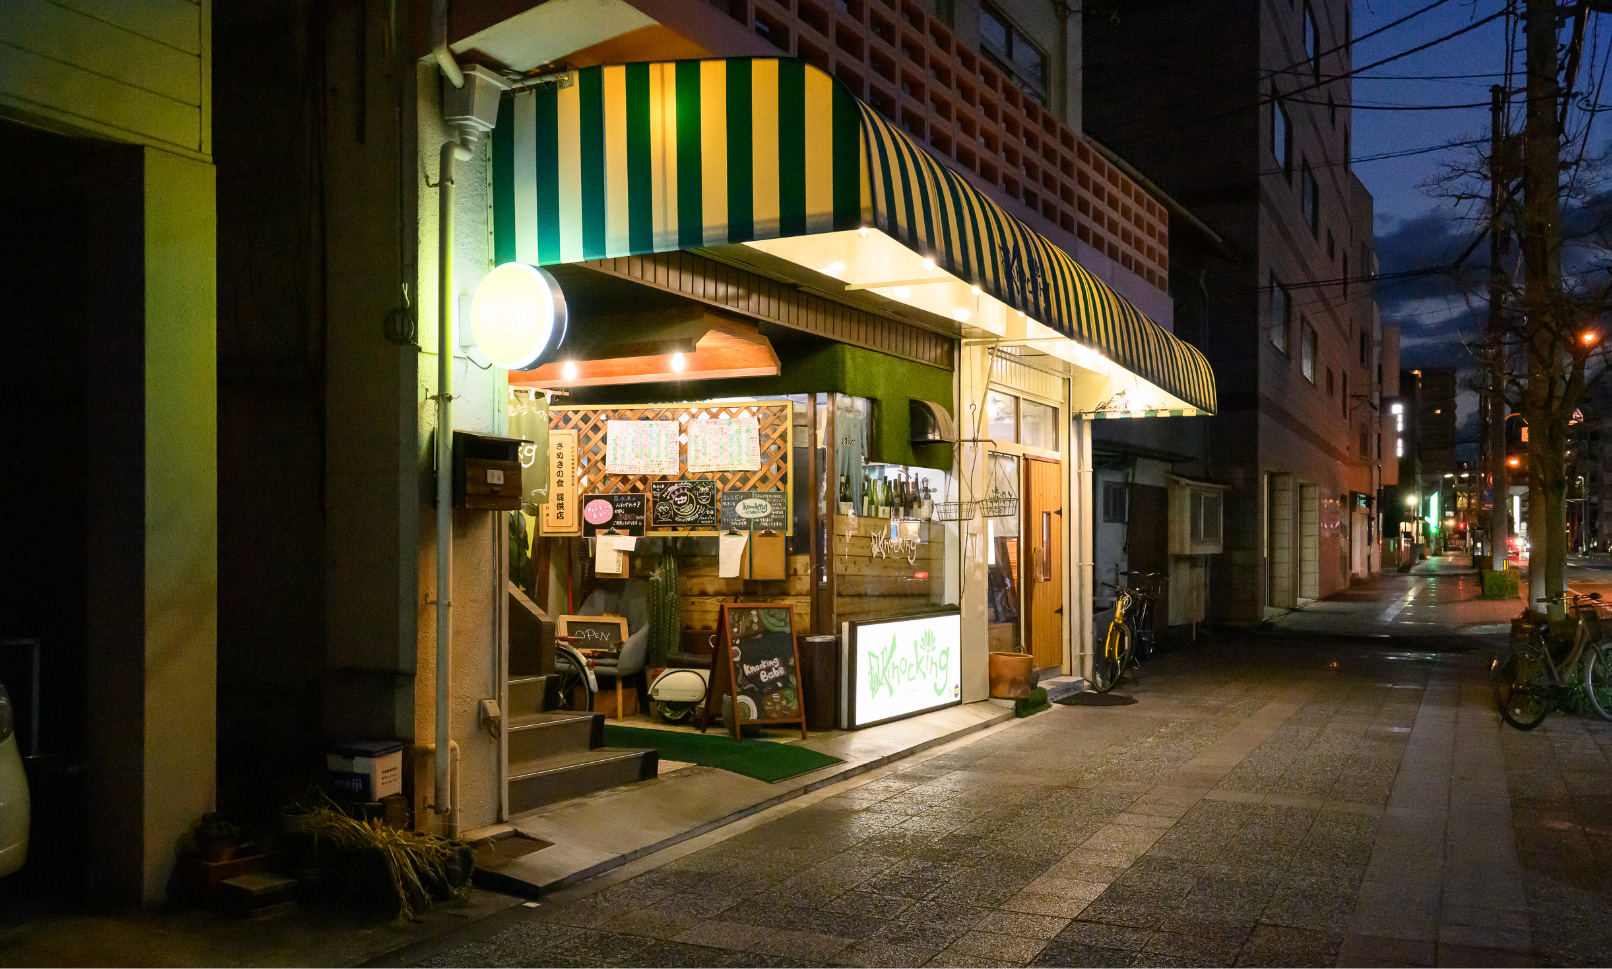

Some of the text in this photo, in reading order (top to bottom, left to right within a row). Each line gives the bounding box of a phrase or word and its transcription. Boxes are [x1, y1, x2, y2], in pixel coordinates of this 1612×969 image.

[743, 657, 780, 676] Knocking
[877, 630, 951, 699] Knocking
[759, 666, 785, 683] Babe
